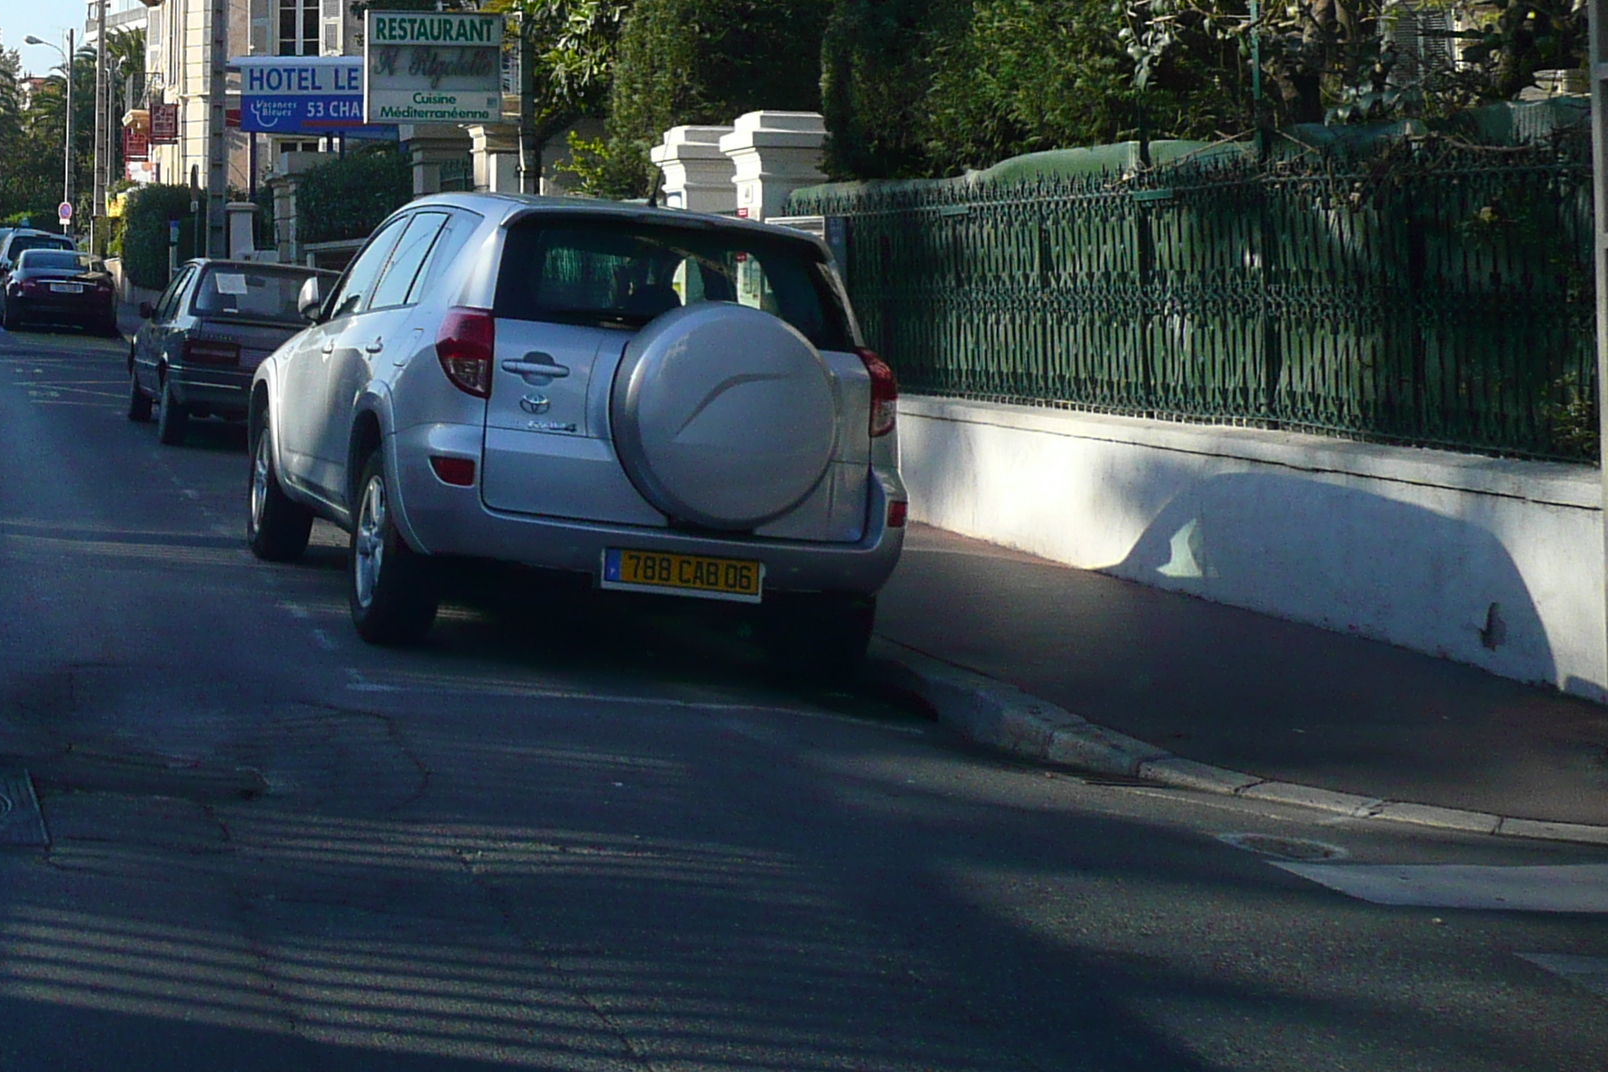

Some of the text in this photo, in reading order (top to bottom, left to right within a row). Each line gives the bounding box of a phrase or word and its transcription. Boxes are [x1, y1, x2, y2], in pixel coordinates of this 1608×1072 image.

[376, 17, 494, 42] RESTAURANT
[249, 67, 359, 91] HOTEL LE
[256, 100, 297, 109] Vacances
[413, 92, 457, 105] Cuisine
[262, 108, 292, 117] Bleues
[307, 101, 363, 118] 53 CHA
[380, 106, 490, 119] Méditerranéenne
[628, 554, 753, 590] 788 CAB 06
